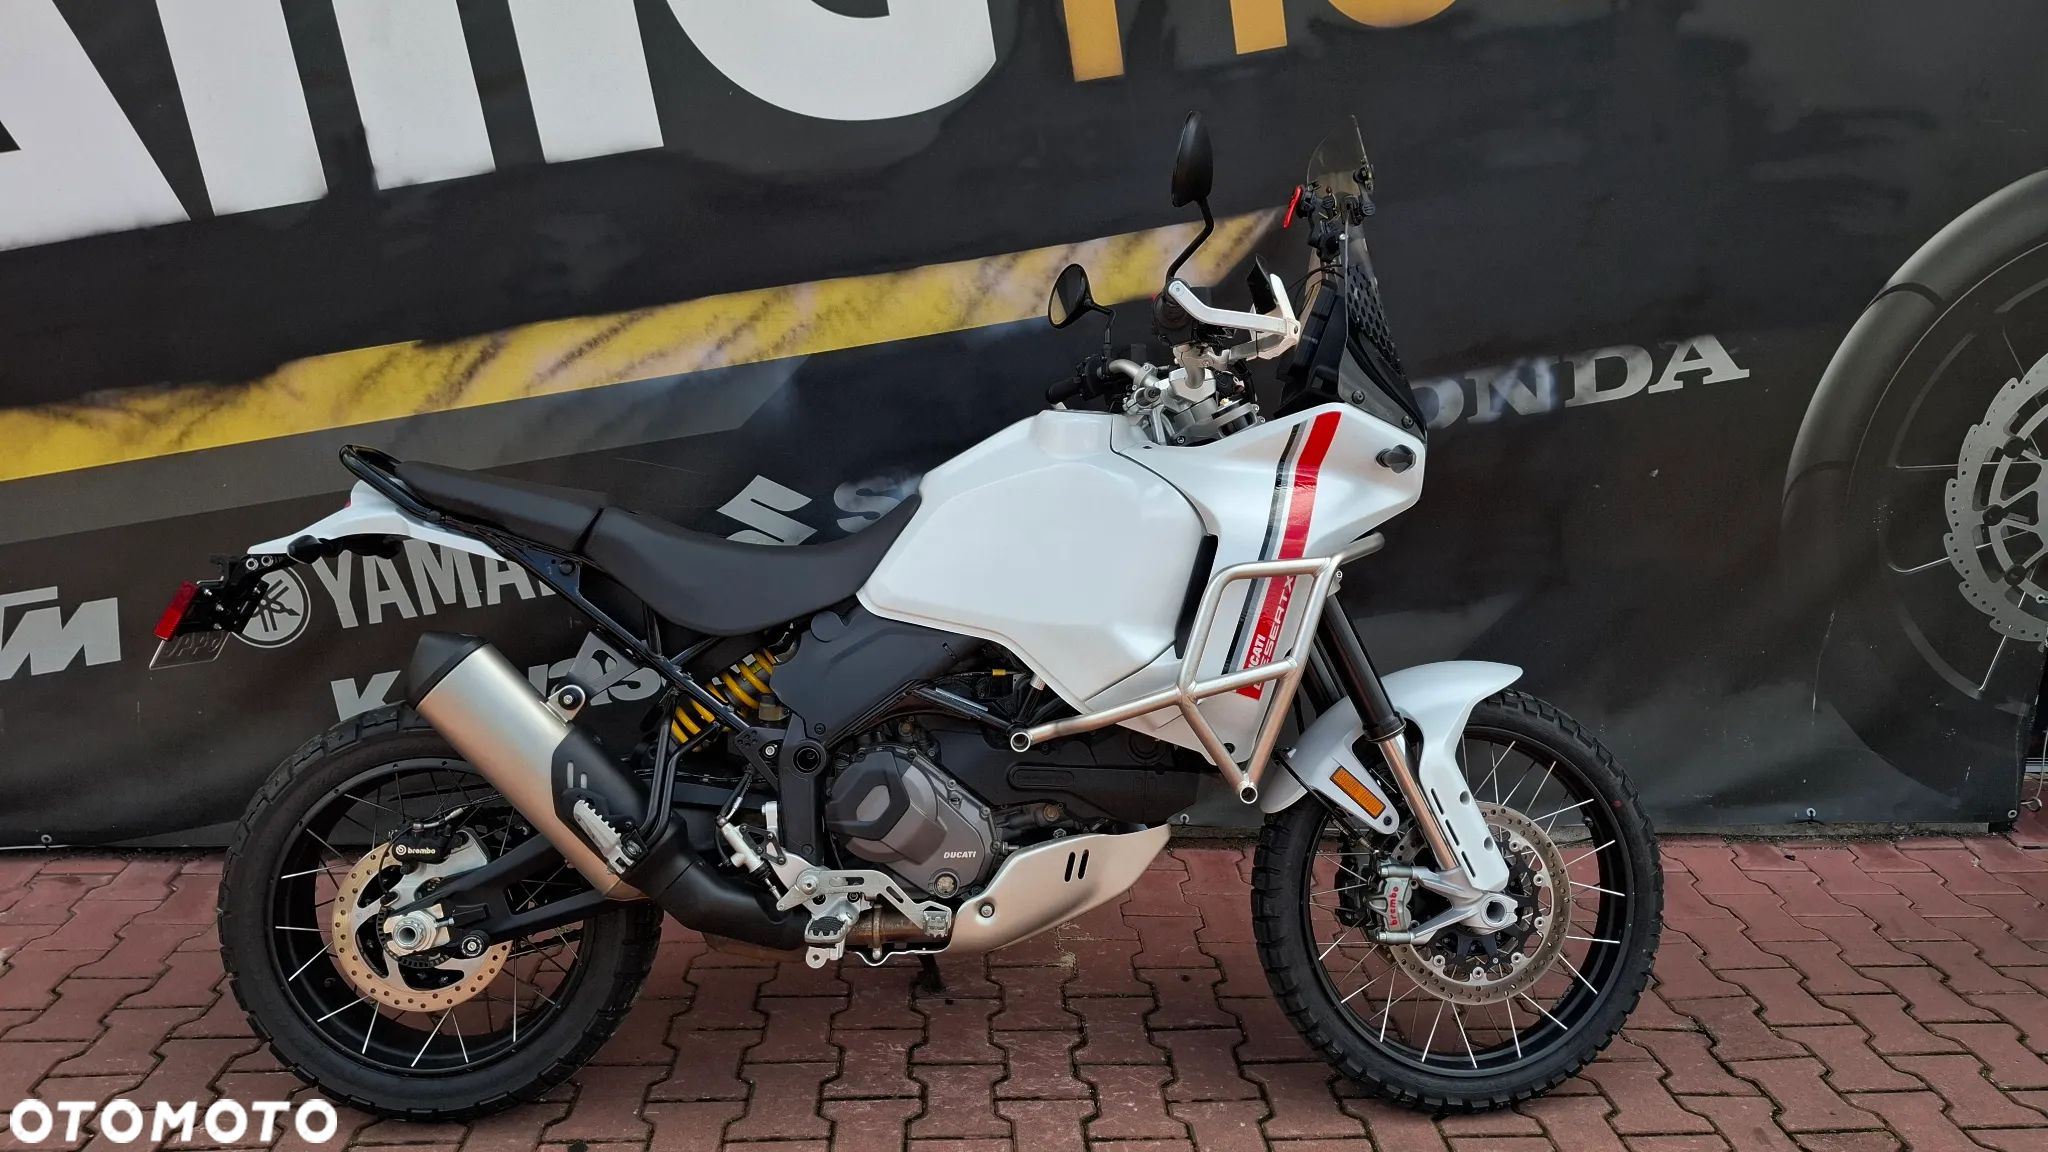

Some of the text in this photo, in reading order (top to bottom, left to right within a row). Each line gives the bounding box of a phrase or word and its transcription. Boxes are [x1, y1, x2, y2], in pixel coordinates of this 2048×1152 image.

[311, 538, 556, 630] YAMA
[407, 846, 436, 854] brembo
[943, 850, 977, 859] DUCATI
[1389, 886, 1399, 926] brembo
